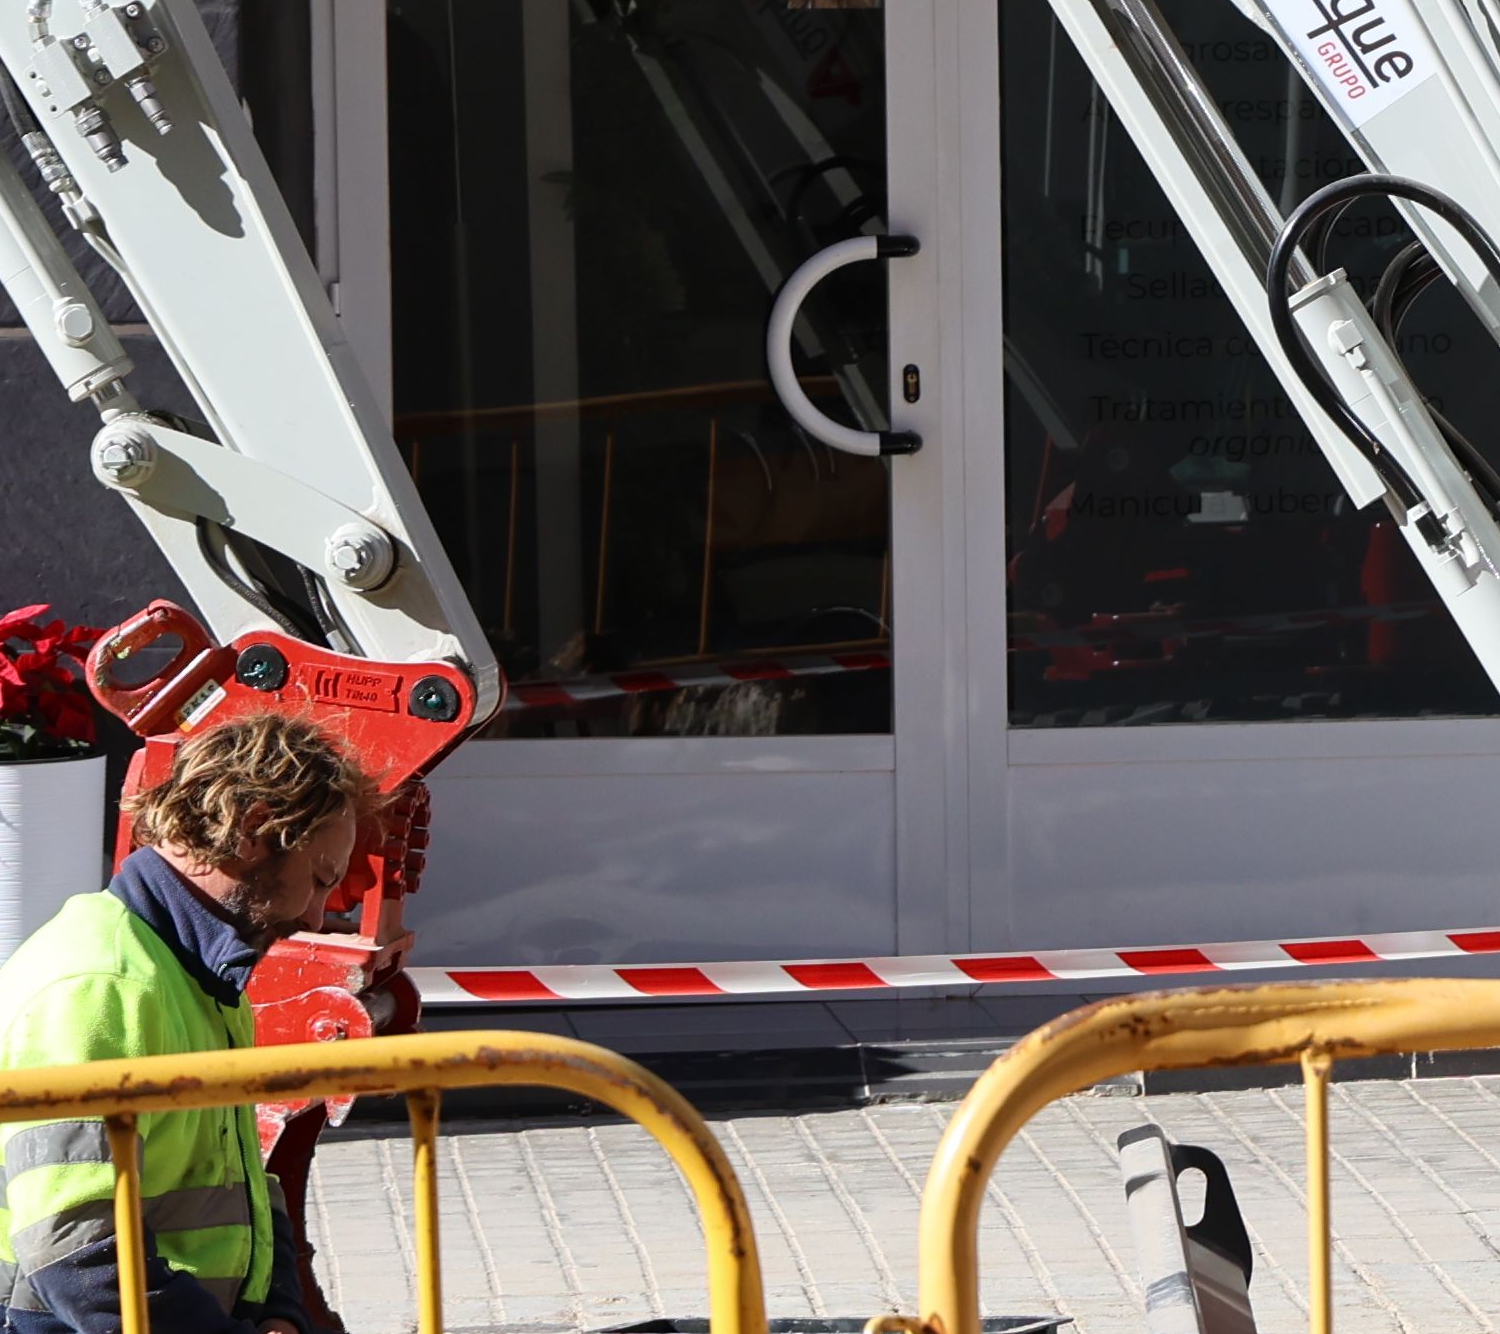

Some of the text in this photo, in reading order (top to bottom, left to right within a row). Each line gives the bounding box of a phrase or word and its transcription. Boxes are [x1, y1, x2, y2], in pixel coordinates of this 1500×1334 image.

[1317, 42, 1366, 100] GRUPO
[1079, 330, 1213, 360] Técnica
[1188, 426, 1325, 462] orgánic
